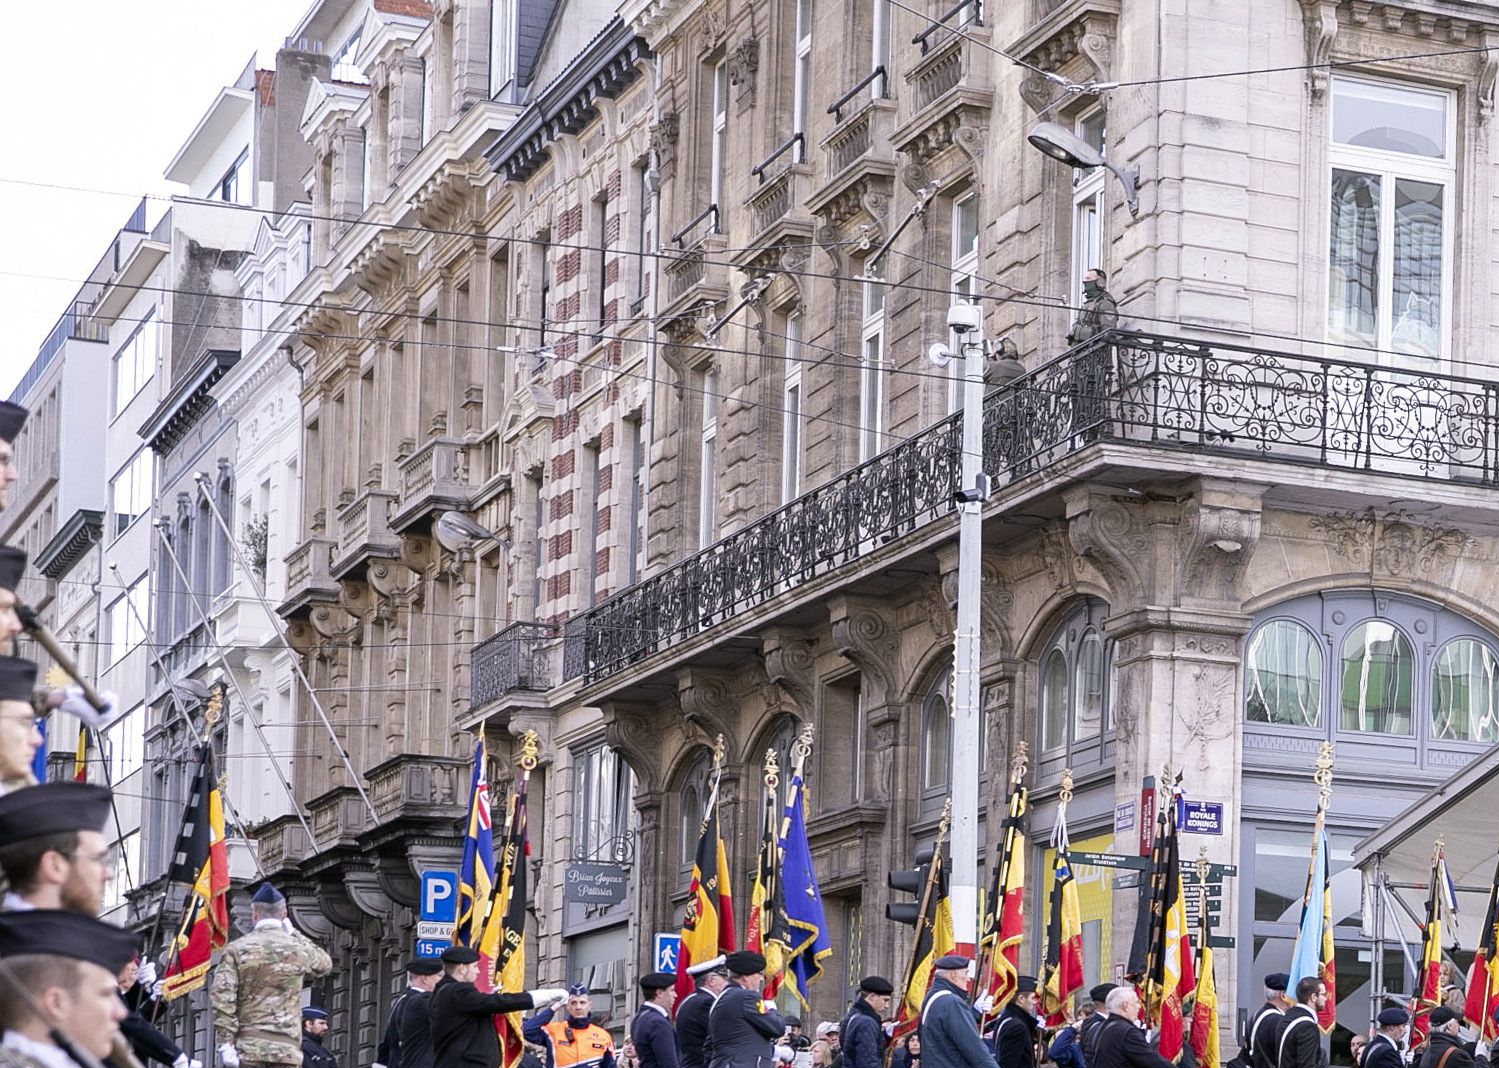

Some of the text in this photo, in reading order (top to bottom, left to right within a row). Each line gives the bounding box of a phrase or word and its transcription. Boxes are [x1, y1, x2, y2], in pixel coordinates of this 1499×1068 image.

[1189, 811, 1216, 820] ROYALE
[1187, 819, 1218, 828] KONINGS
[568, 870, 624, 885] Brian Joyeux
[426, 878, 452, 914] P
[421, 926, 438, 935] SHOP
[439, 928, 445, 936] &
[420, 943, 433, 955] 15
